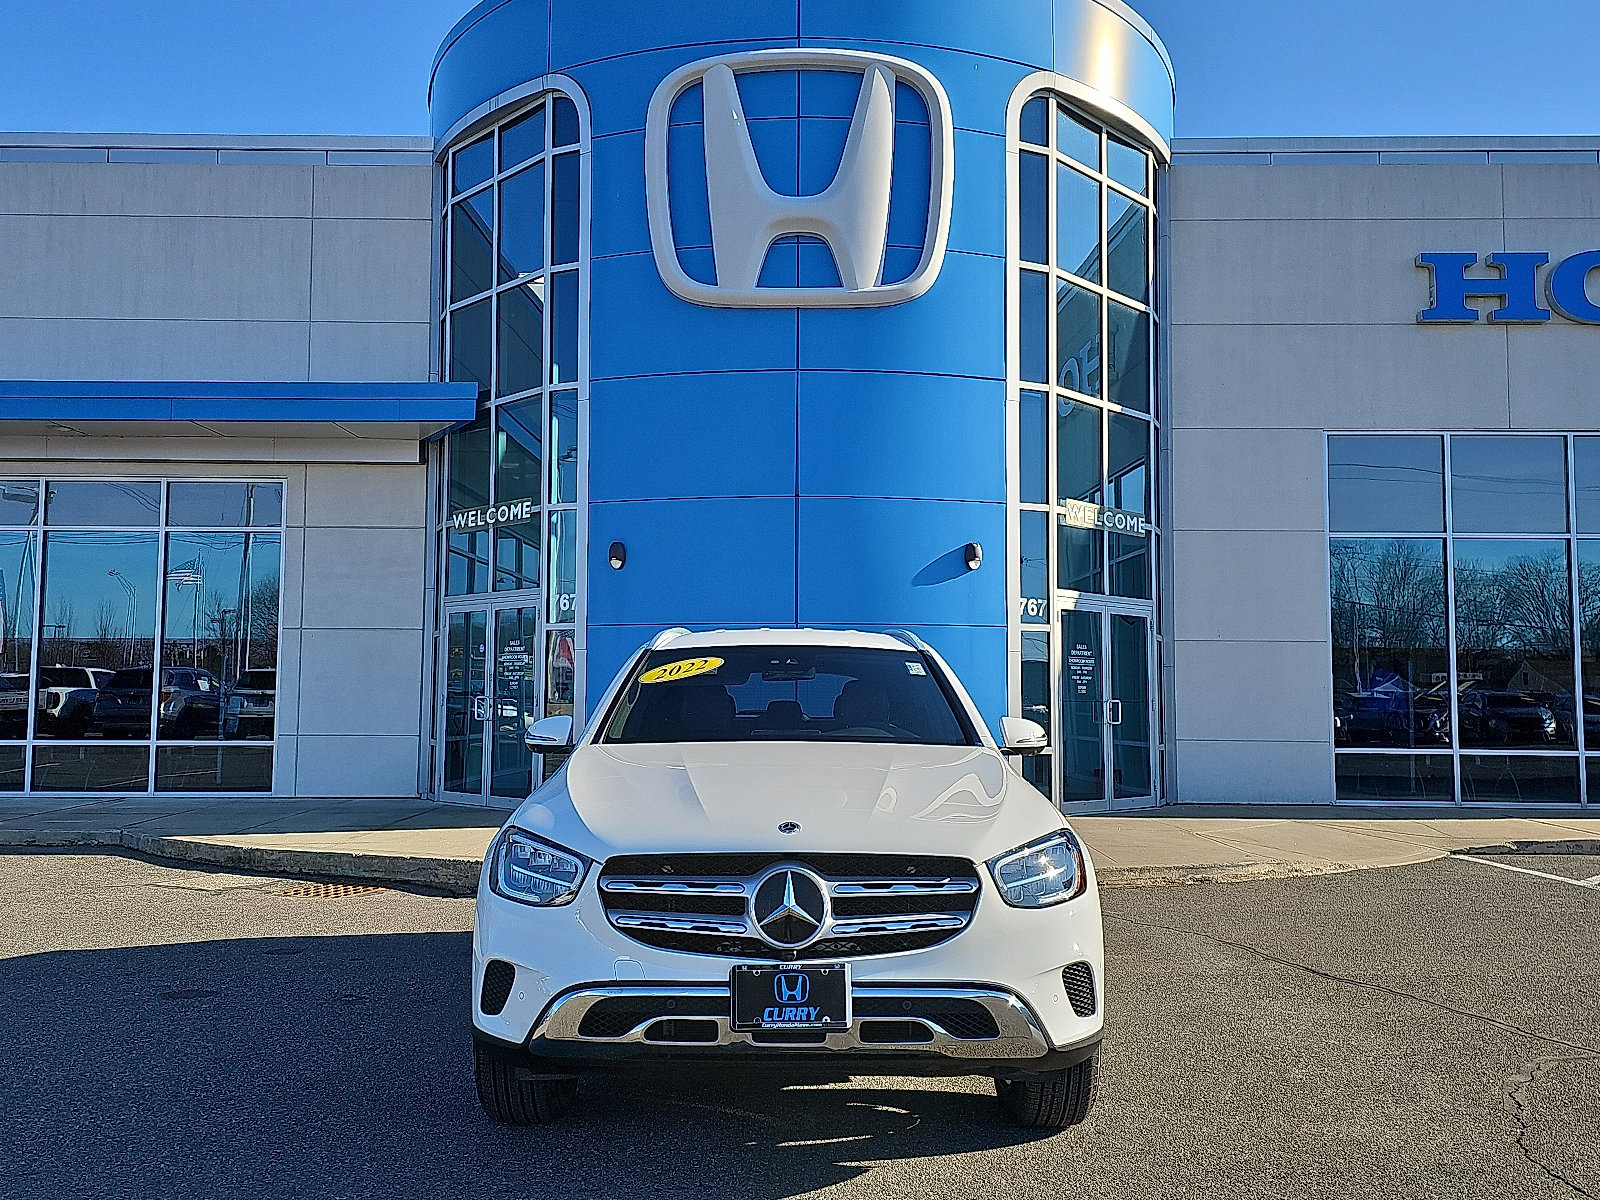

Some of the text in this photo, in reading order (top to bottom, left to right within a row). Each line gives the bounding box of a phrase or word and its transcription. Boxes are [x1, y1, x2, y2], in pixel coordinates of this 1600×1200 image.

[452, 501, 532, 530] WELCOME
[1067, 502, 1147, 534] WELCOME
[1019, 598, 1047, 617] 767
[653, 660, 709, 681] 2022
[763, 1007, 820, 1022] CURRY
